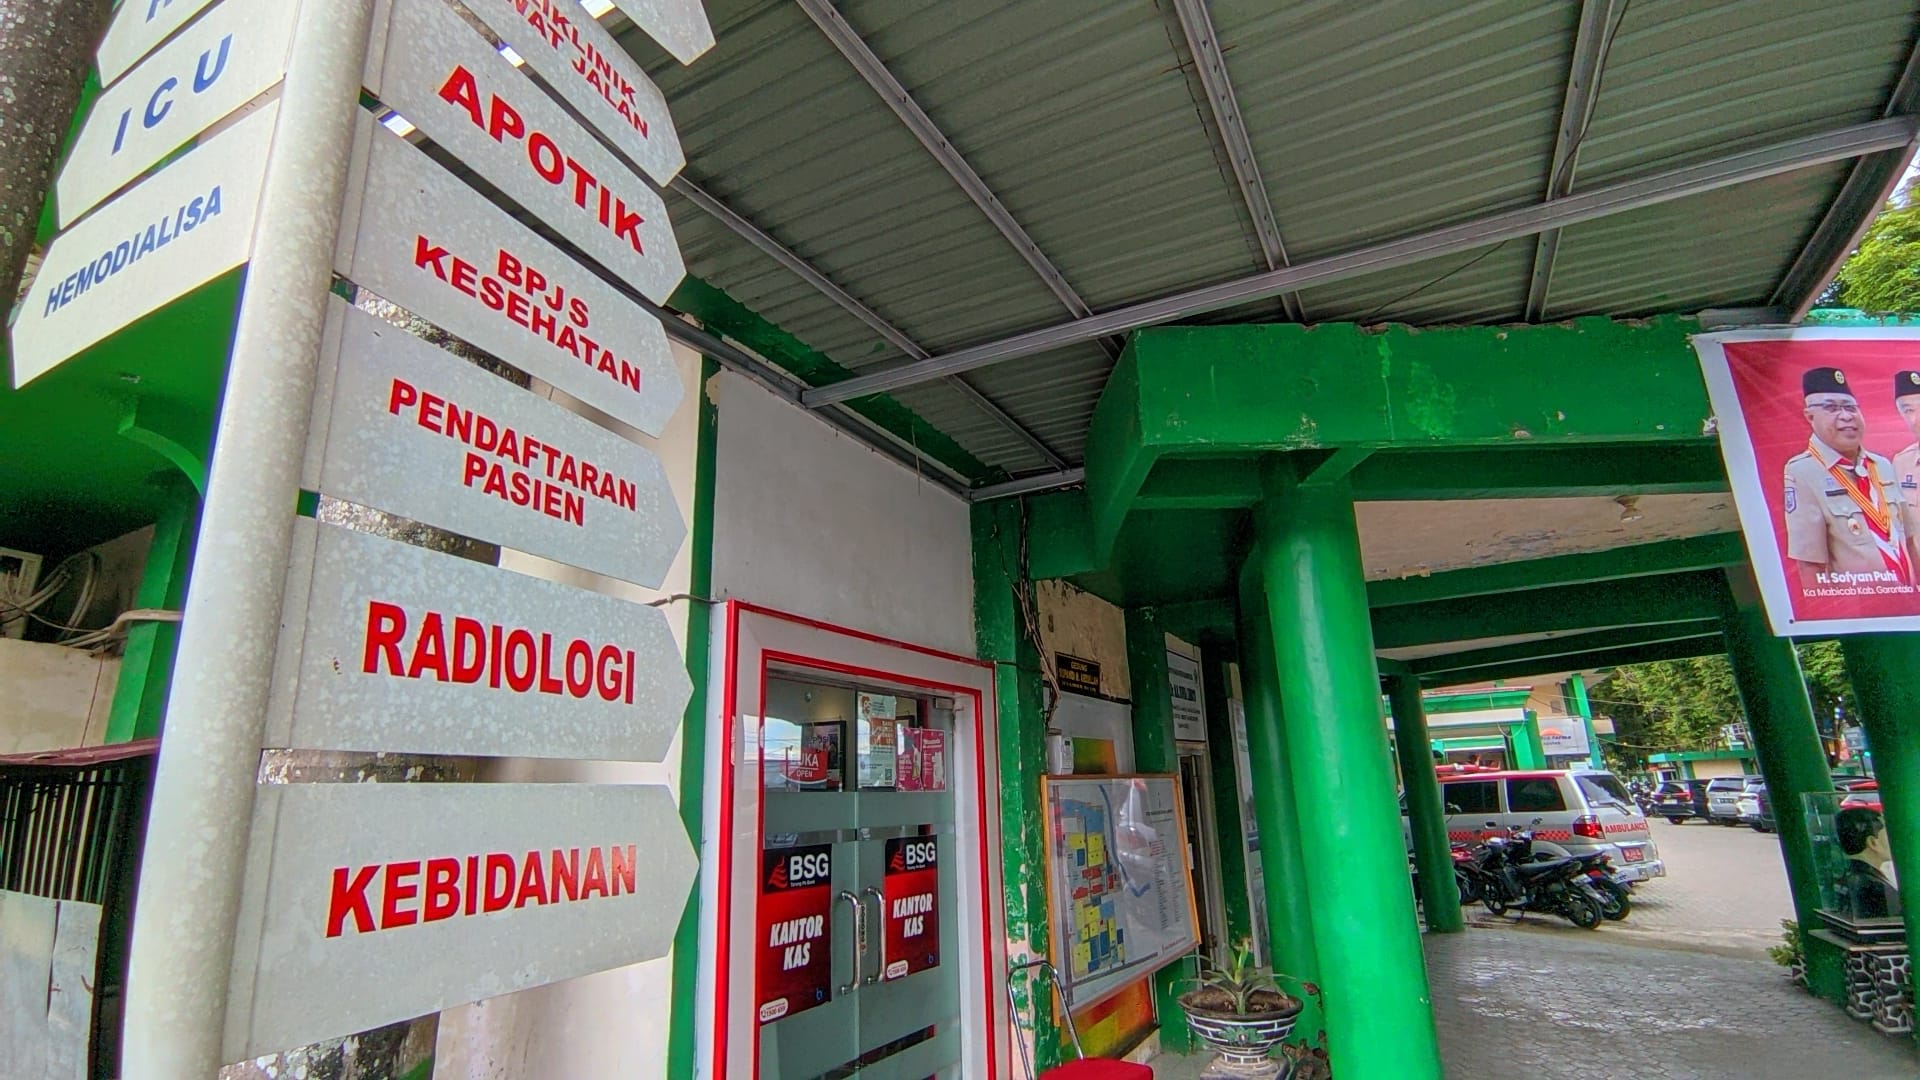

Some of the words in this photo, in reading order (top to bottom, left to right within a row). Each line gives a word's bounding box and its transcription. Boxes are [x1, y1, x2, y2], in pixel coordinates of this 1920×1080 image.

[572, 57, 648, 139] JALAN
[439, 65, 646, 255] APOTIK
[44, 185, 223, 318] HEMODIALISA
[497, 248, 590, 329] BPJS
[414, 234, 641, 393] KESEHATAN
[387, 378, 637, 512] PENDAFTARAN
[463, 452, 585, 526] PASIEN
[1803, 588, 1816, 597] Ka
[1817, 586, 1856, 596] Mabicab
[1876, 584, 1914, 594] Gorontalo
[1816, 572, 1831, 584] H.
[1831, 571, 1872, 586] Sofyan
[1873, 569, 1898, 582] Puhi
[362, 600, 636, 705] RADIOLOGI
[796, 769, 813, 778] OPEN
[1604, 822, 1647, 833] AMBULANCE
[790, 852, 829, 881] BSG
[906, 841, 936, 865] BSG
[325, 845, 637, 939] KEBIDANAN
[893, 893, 933, 919] KANTOR
[769, 914, 824, 948] KANTOR
[903, 915, 924, 938] KAS
[783, 942, 811, 971] KAS
